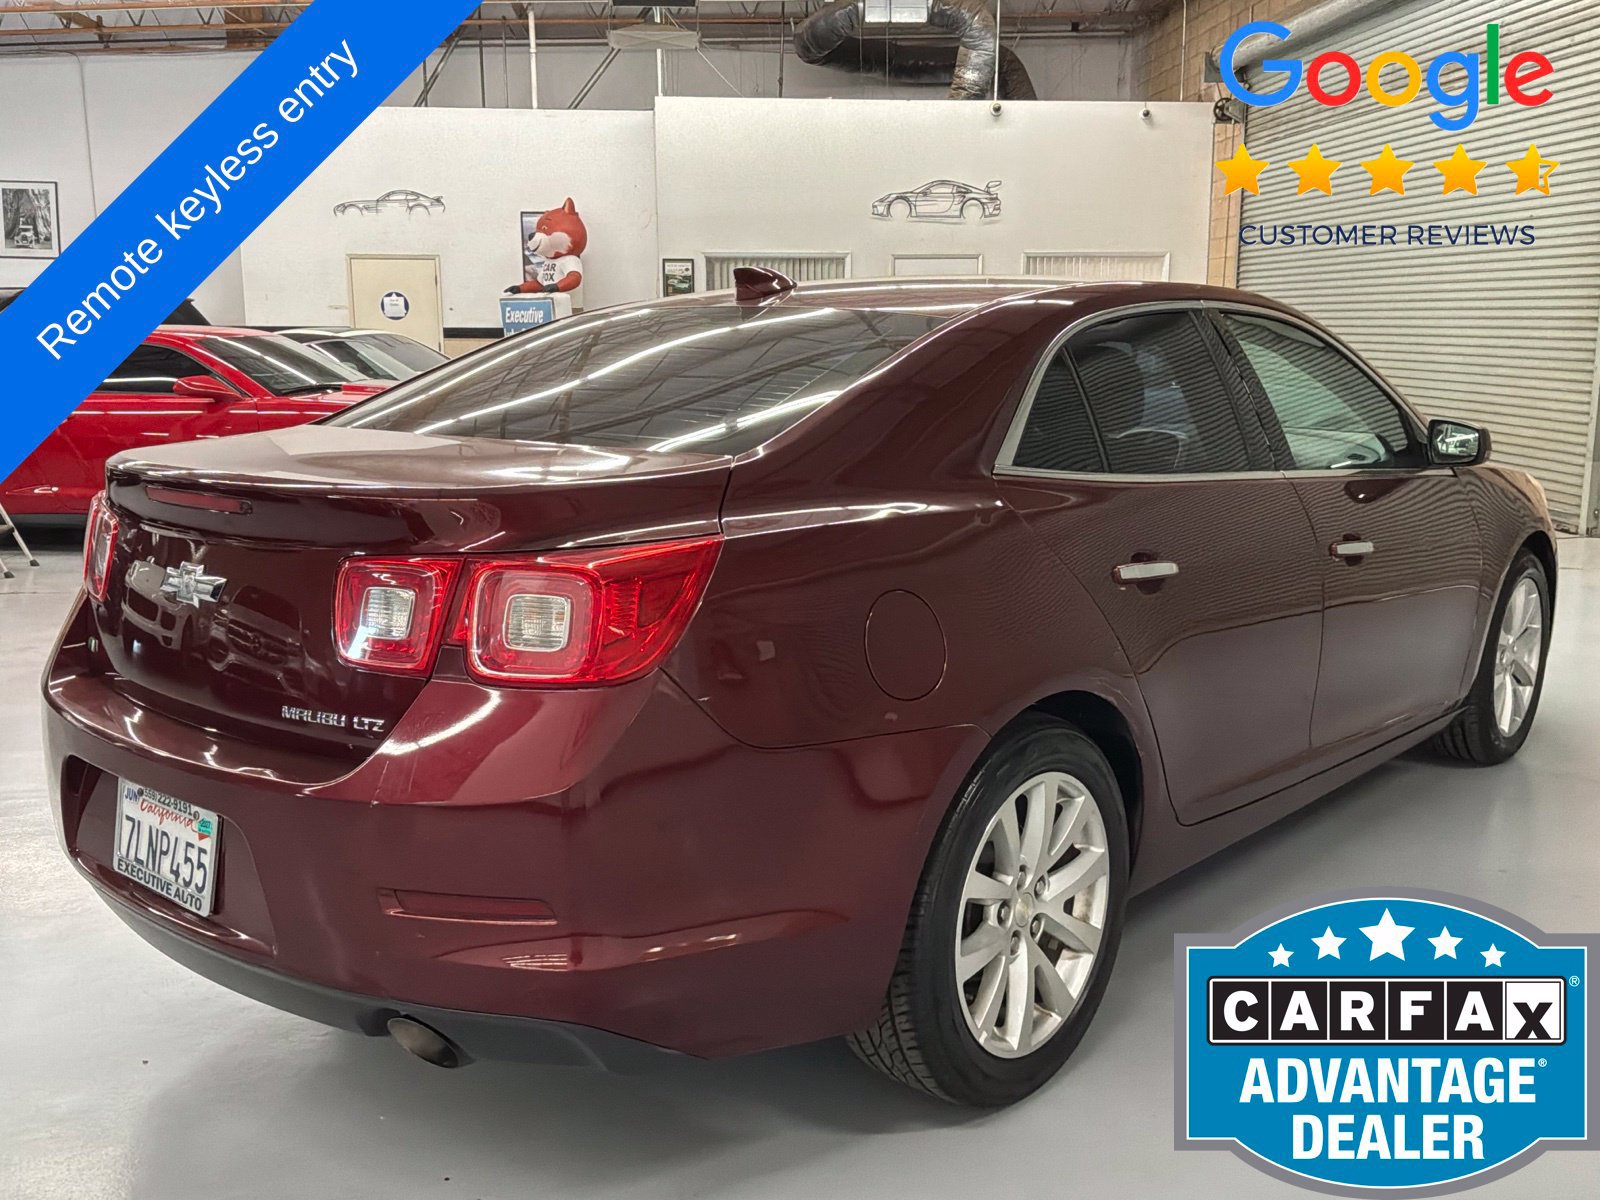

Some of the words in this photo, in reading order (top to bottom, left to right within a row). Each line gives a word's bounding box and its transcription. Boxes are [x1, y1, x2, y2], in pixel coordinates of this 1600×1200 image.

[543, 272, 555, 282] OX
[505, 306, 544, 323] Executive
[281, 705, 346, 727] MALIBU
[352, 716, 385, 732] LTZ
[140, 799, 198, 832] California
[125, 814, 208, 894] 7LNP455
[117, 858, 173, 898] EXECUTIVE
[173, 886, 203, 912] AUTO
